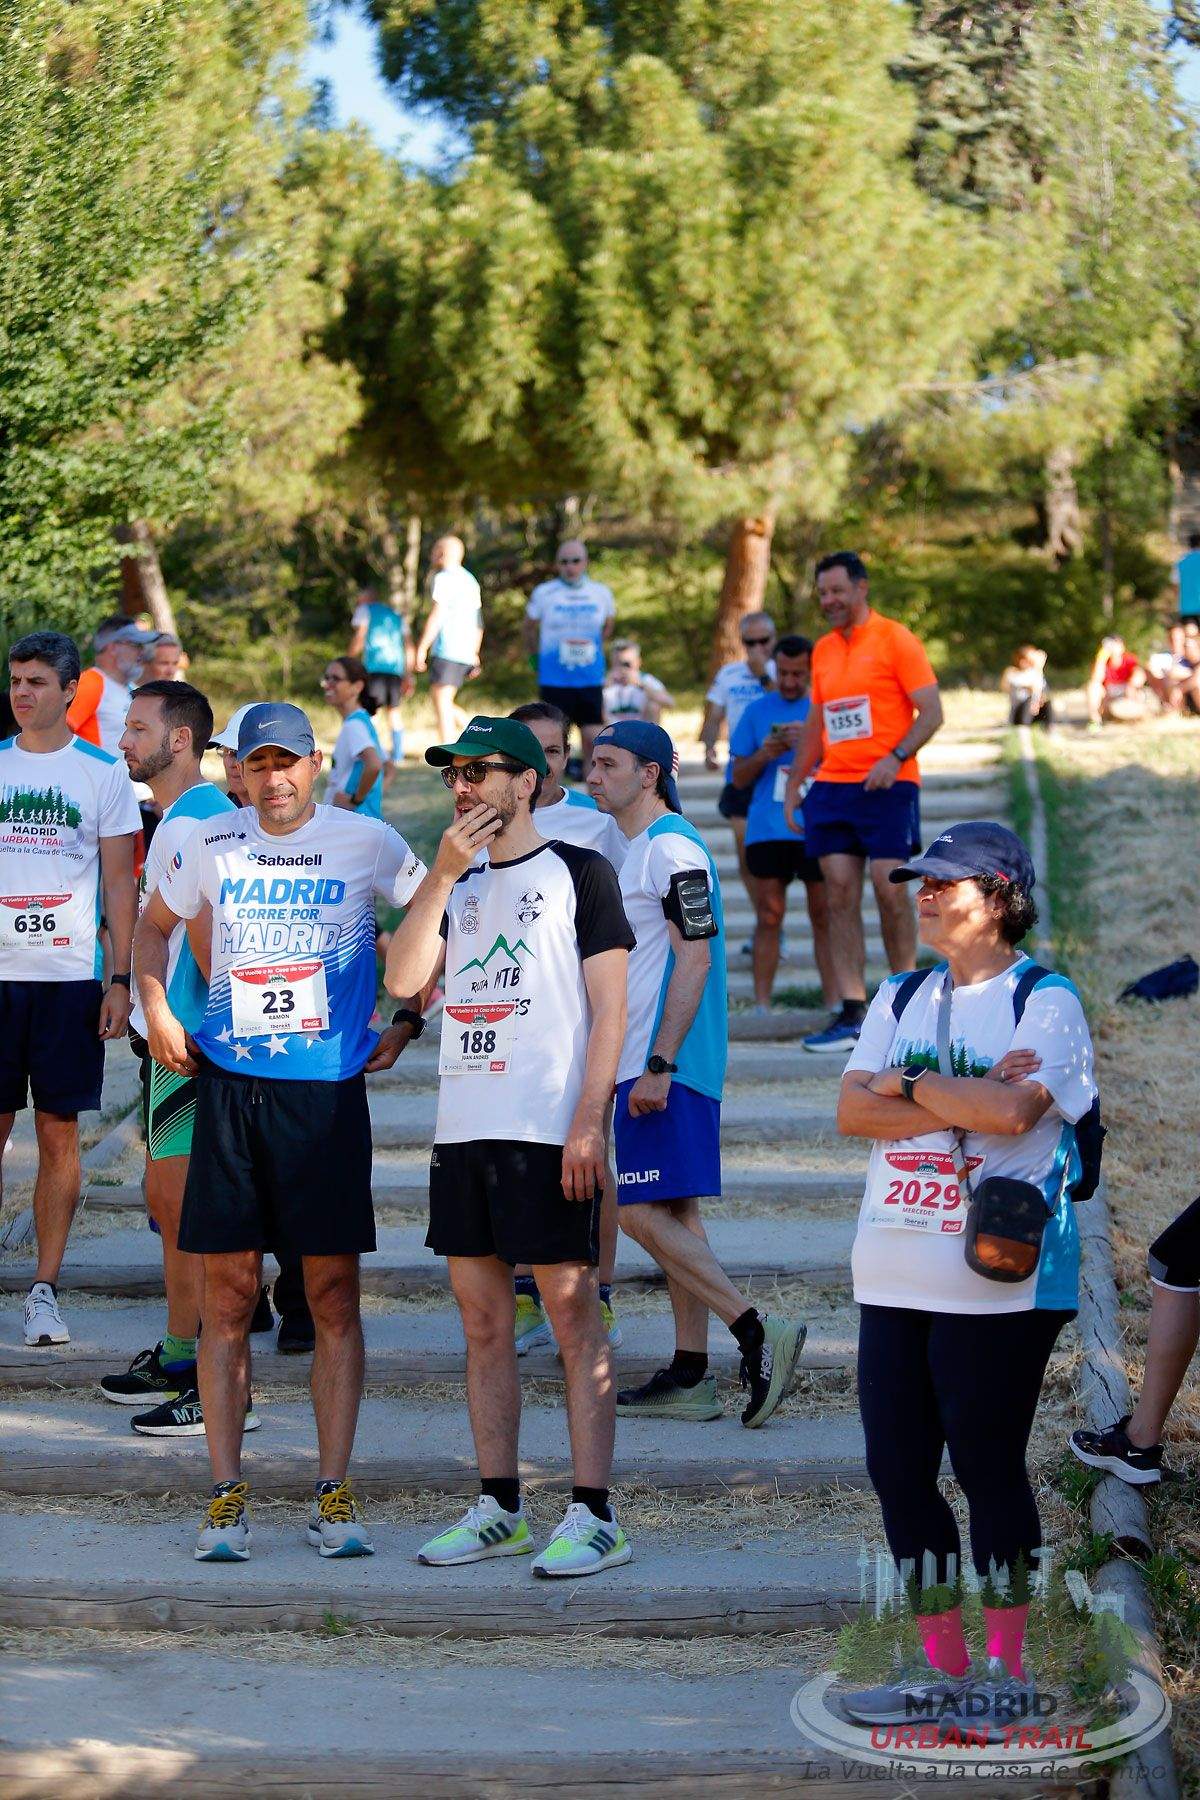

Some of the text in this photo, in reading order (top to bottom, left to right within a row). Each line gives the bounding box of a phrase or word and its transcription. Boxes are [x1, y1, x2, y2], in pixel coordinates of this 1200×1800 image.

[831, 713, 863, 731] 1355
[12, 825, 58, 836] MADRID
[1, 835, 65, 848] URBAN TRAIL
[23, 846, 30, 854] la
[31, 847, 51, 856] Casa
[51, 848, 60, 857] de
[256, 854, 323, 867] Sabadell
[219, 877, 347, 906] MADRID
[236, 908, 321, 921] CORRE POR
[14, 913, 56, 933] 636
[219, 922, 342, 954] MADRID
[275, 966, 290, 974] Casa
[298, 964, 319, 972] Campo
[471, 979, 489, 994] RUTA
[261, 989, 296, 1014] 23
[460, 1030, 497, 1054] 188
[884, 1180, 961, 1211] 2029
[902, 1208, 935, 1216] MERCEDES
